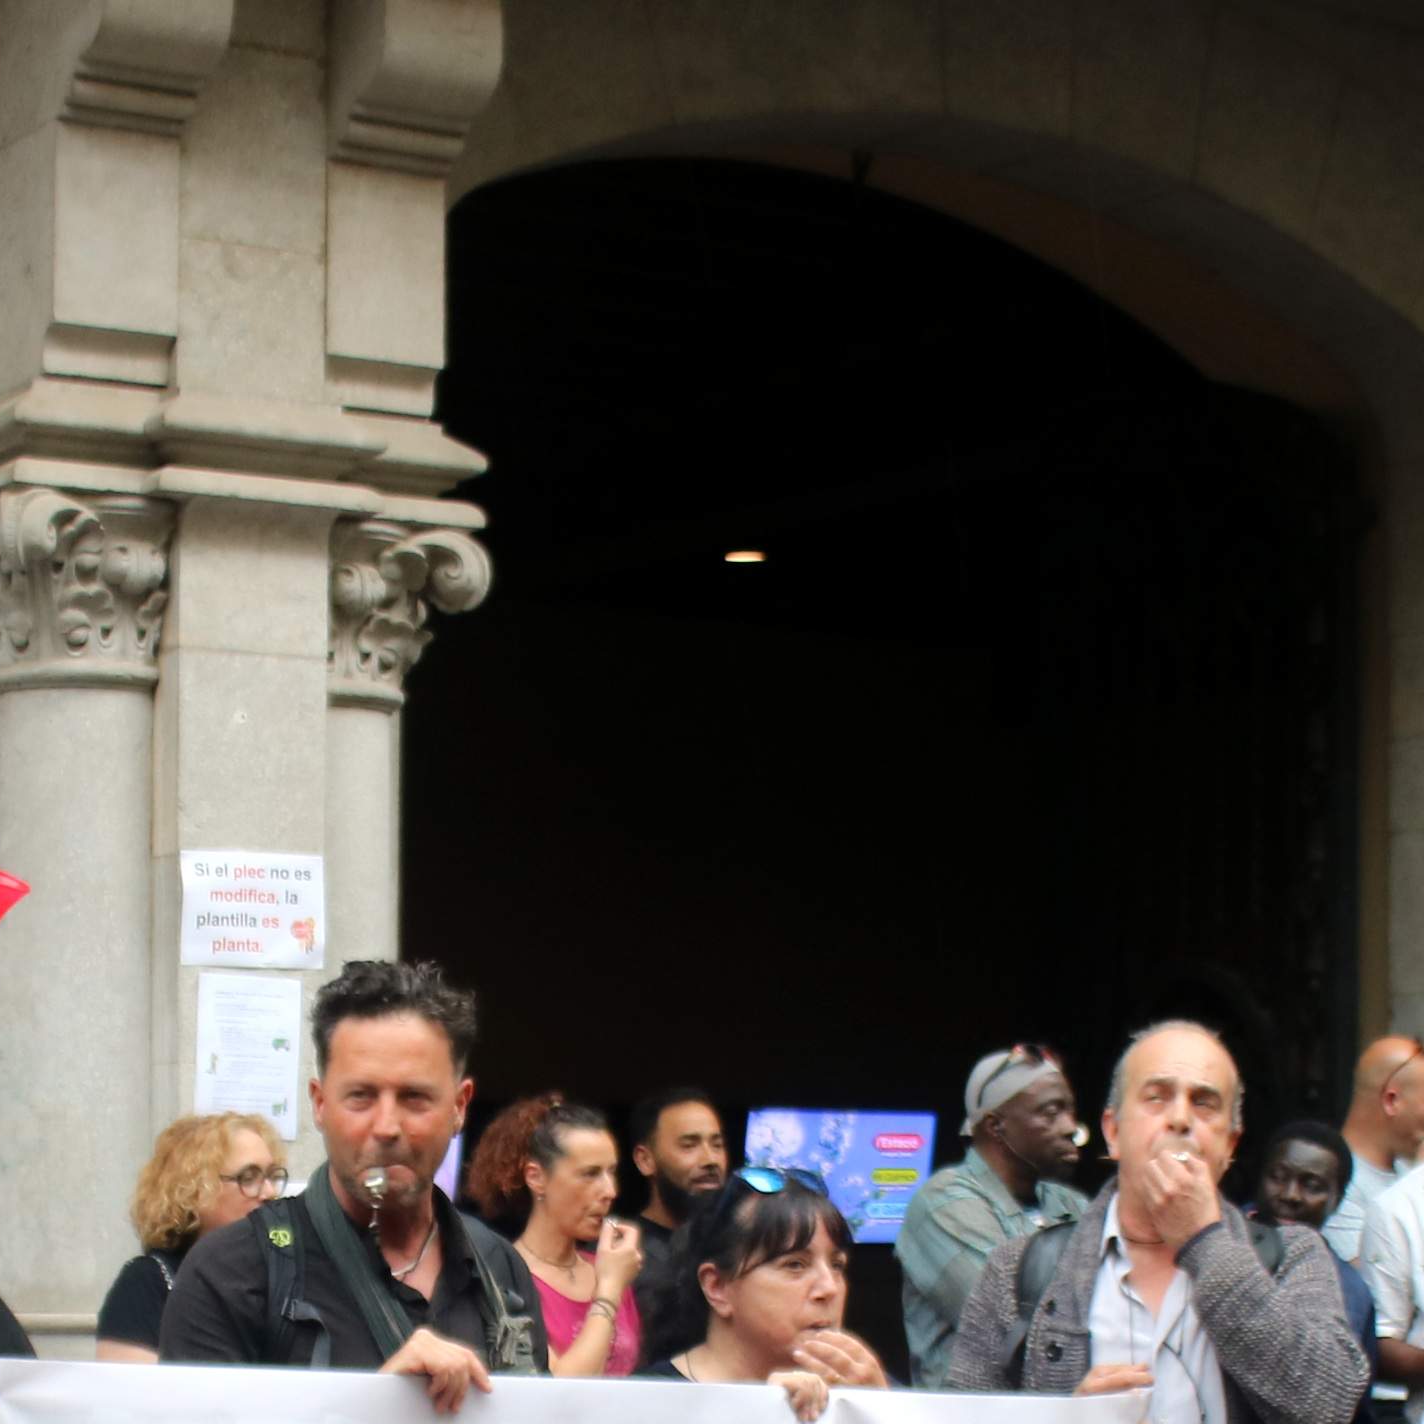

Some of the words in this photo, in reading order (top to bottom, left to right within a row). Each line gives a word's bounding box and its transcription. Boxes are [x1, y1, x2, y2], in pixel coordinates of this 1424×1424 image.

[194, 862, 210, 877] Si
[215, 864, 228, 878] el
[233, 865, 266, 880] plec
[270, 868, 290, 880] no
[294, 869, 311, 881] es
[285, 890, 299, 905] la
[196, 911, 257, 930] plantilla
[261, 916, 280, 929] es
